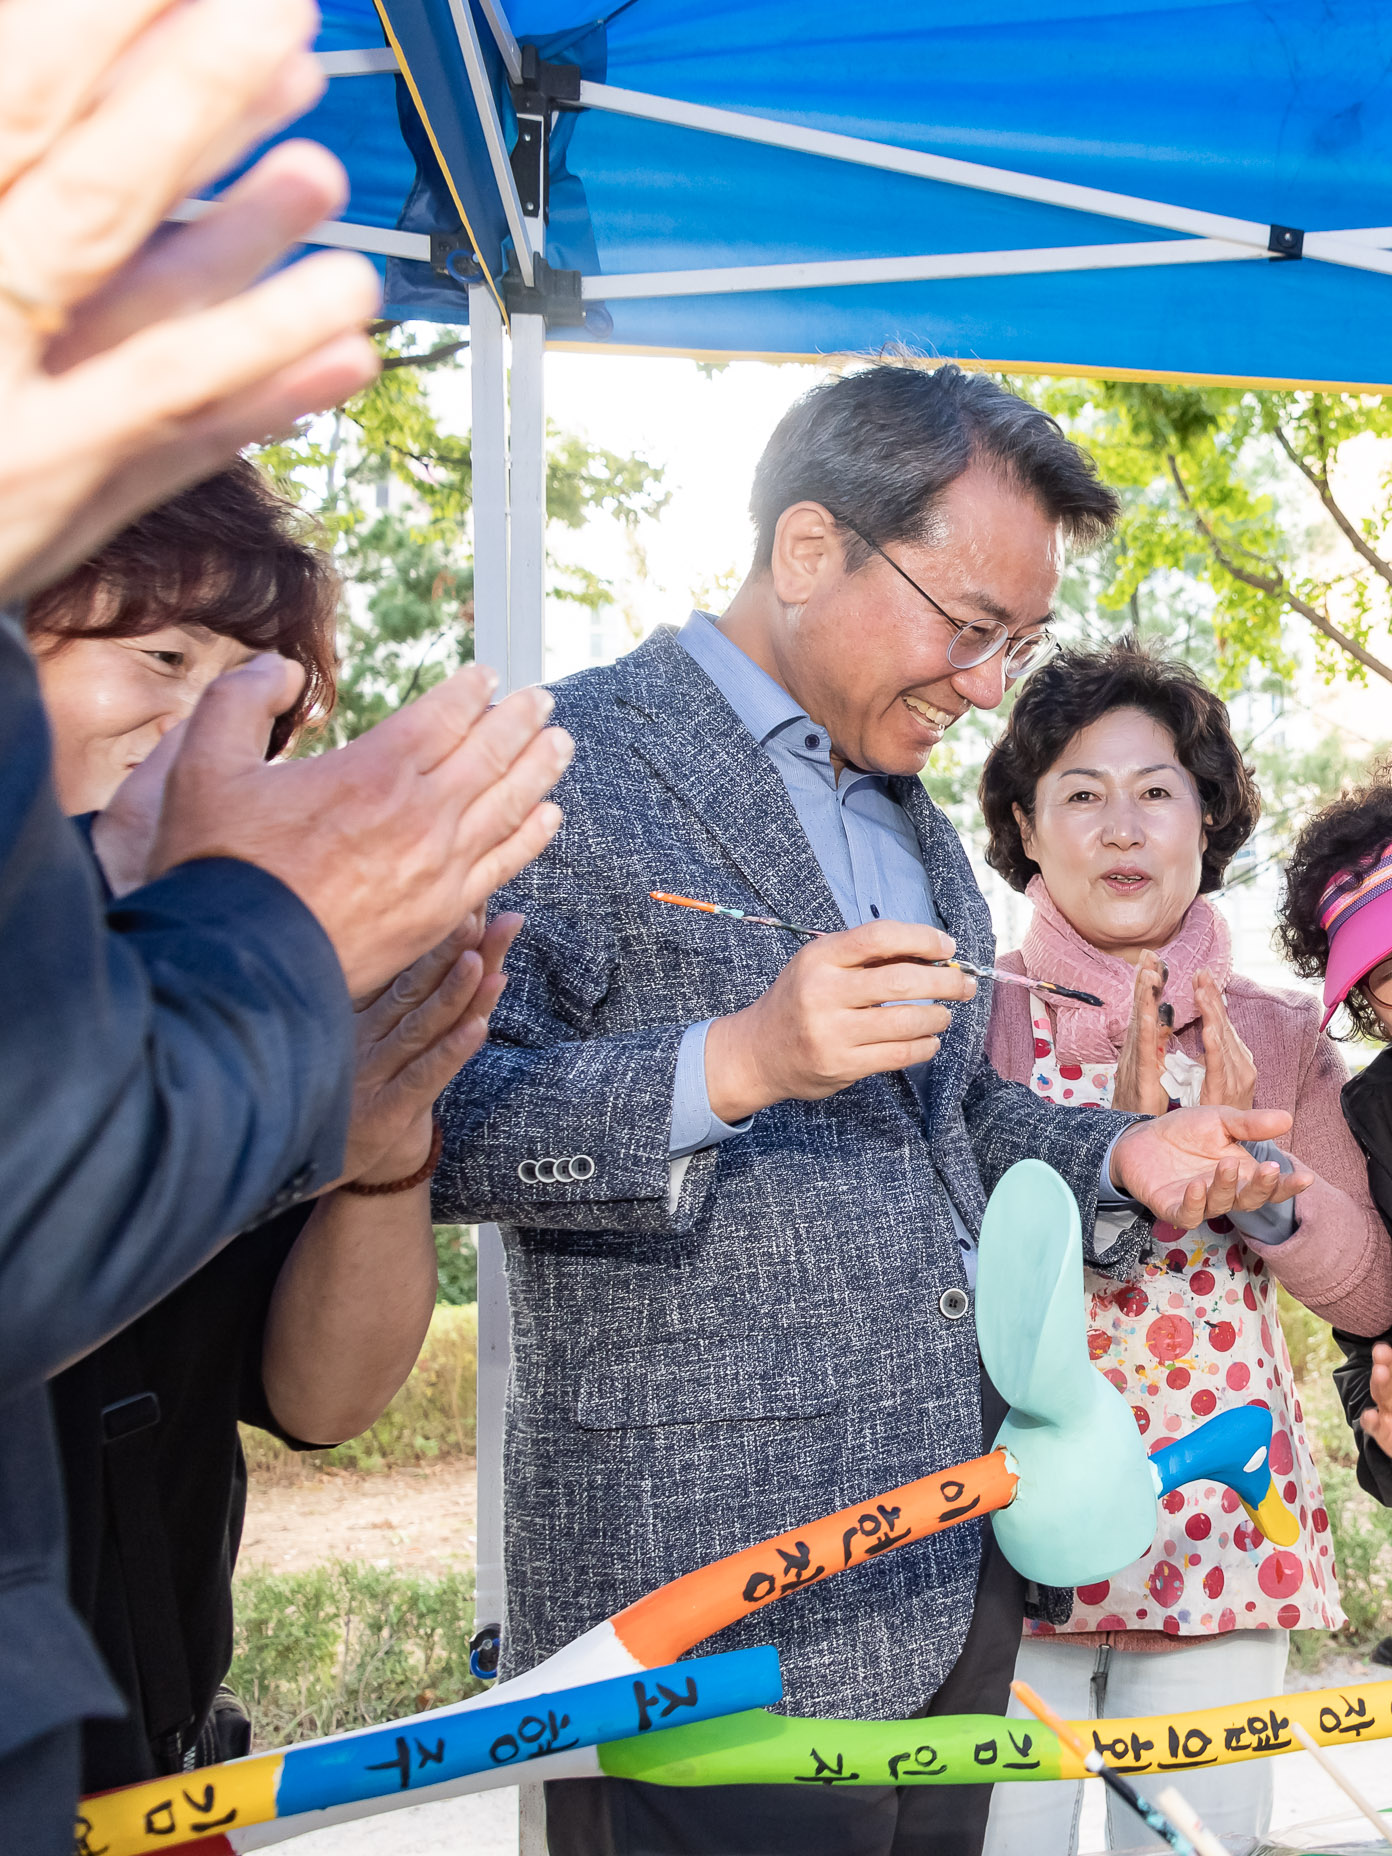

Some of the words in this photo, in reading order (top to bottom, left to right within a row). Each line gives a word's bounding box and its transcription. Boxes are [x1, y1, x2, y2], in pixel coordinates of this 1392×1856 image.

[742, 1480, 981, 1603] 이현정
[364, 1676, 699, 1788] 조형주
[794, 1729, 1041, 1786] 김인자
